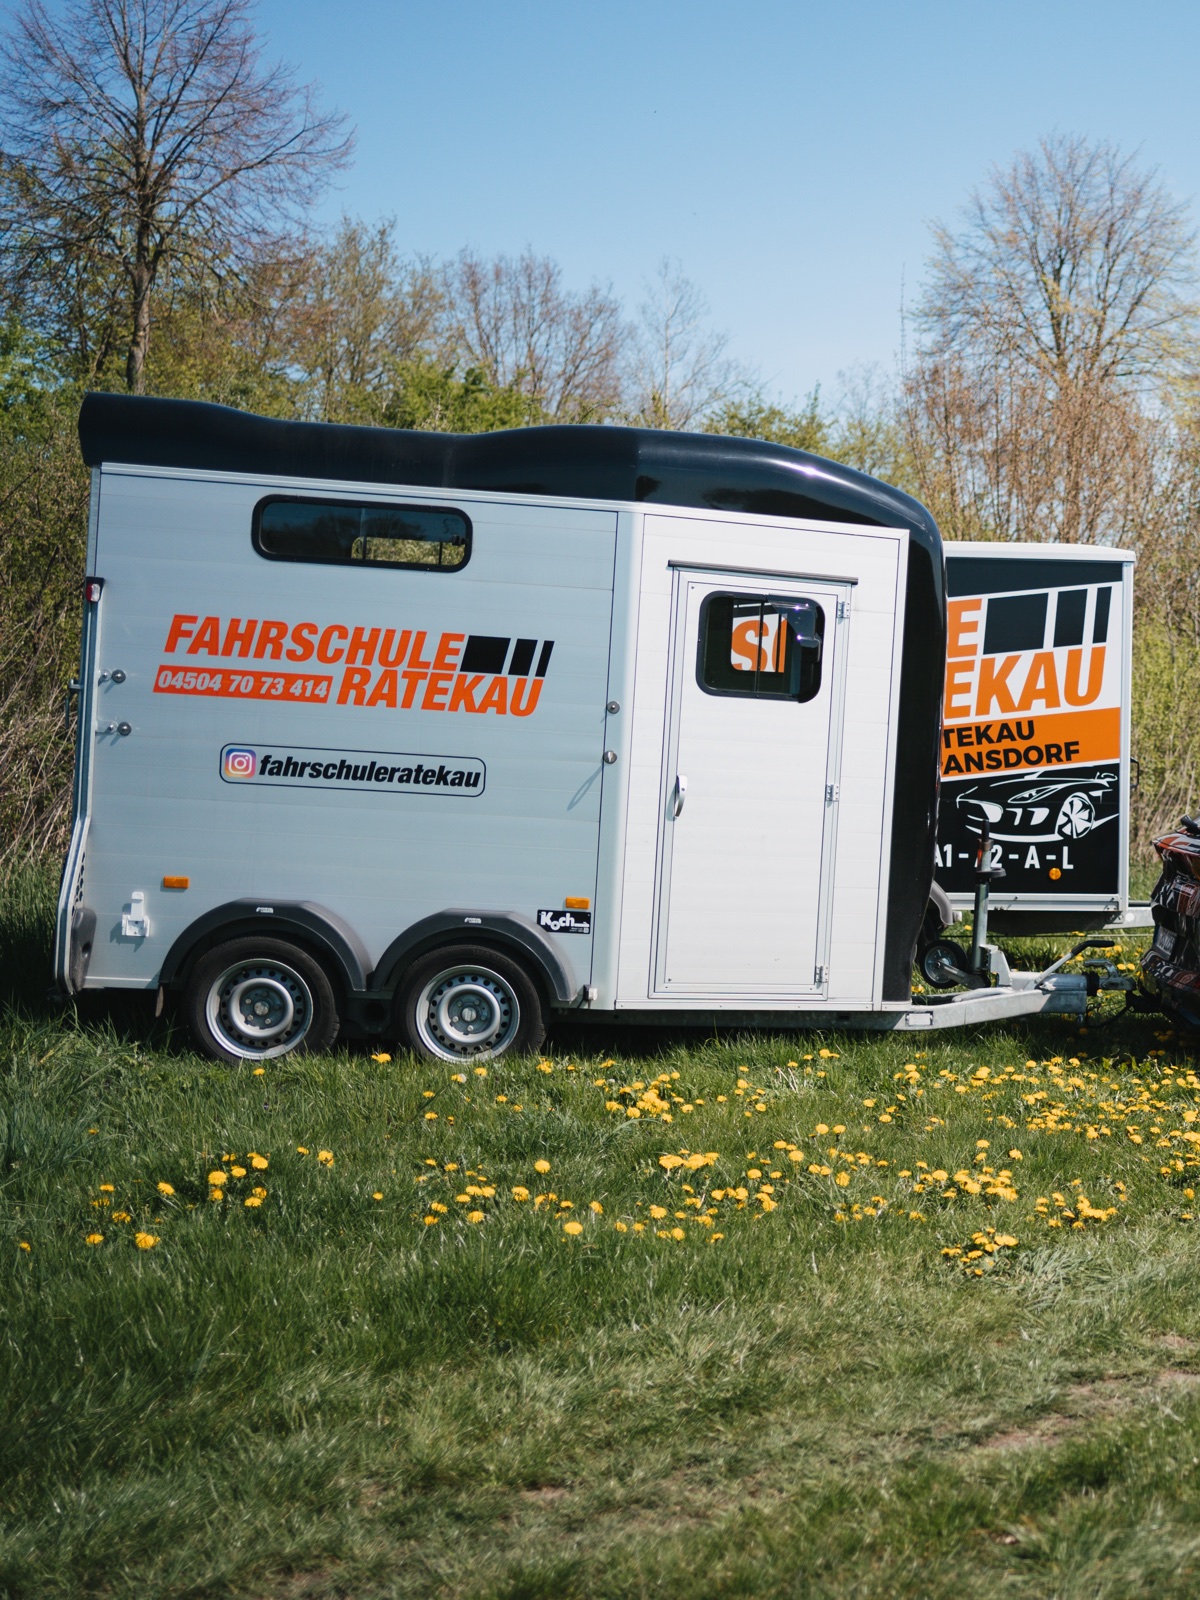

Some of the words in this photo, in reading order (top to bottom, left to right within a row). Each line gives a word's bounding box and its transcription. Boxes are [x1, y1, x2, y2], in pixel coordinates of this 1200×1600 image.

[163, 614, 466, 672] FAHRSCHULE
[157, 670, 223, 691] 04504
[228, 675, 254, 694] 70
[260, 677, 285, 696] 73
[289, 679, 329, 698] 414
[335, 666, 544, 717] RATEKAU
[258, 754, 481, 788] fahrschuleratekau
[941, 741, 1080, 775] ANSDORF
[1062, 846, 1074, 870] L
[540, 911, 575, 931] Koch
